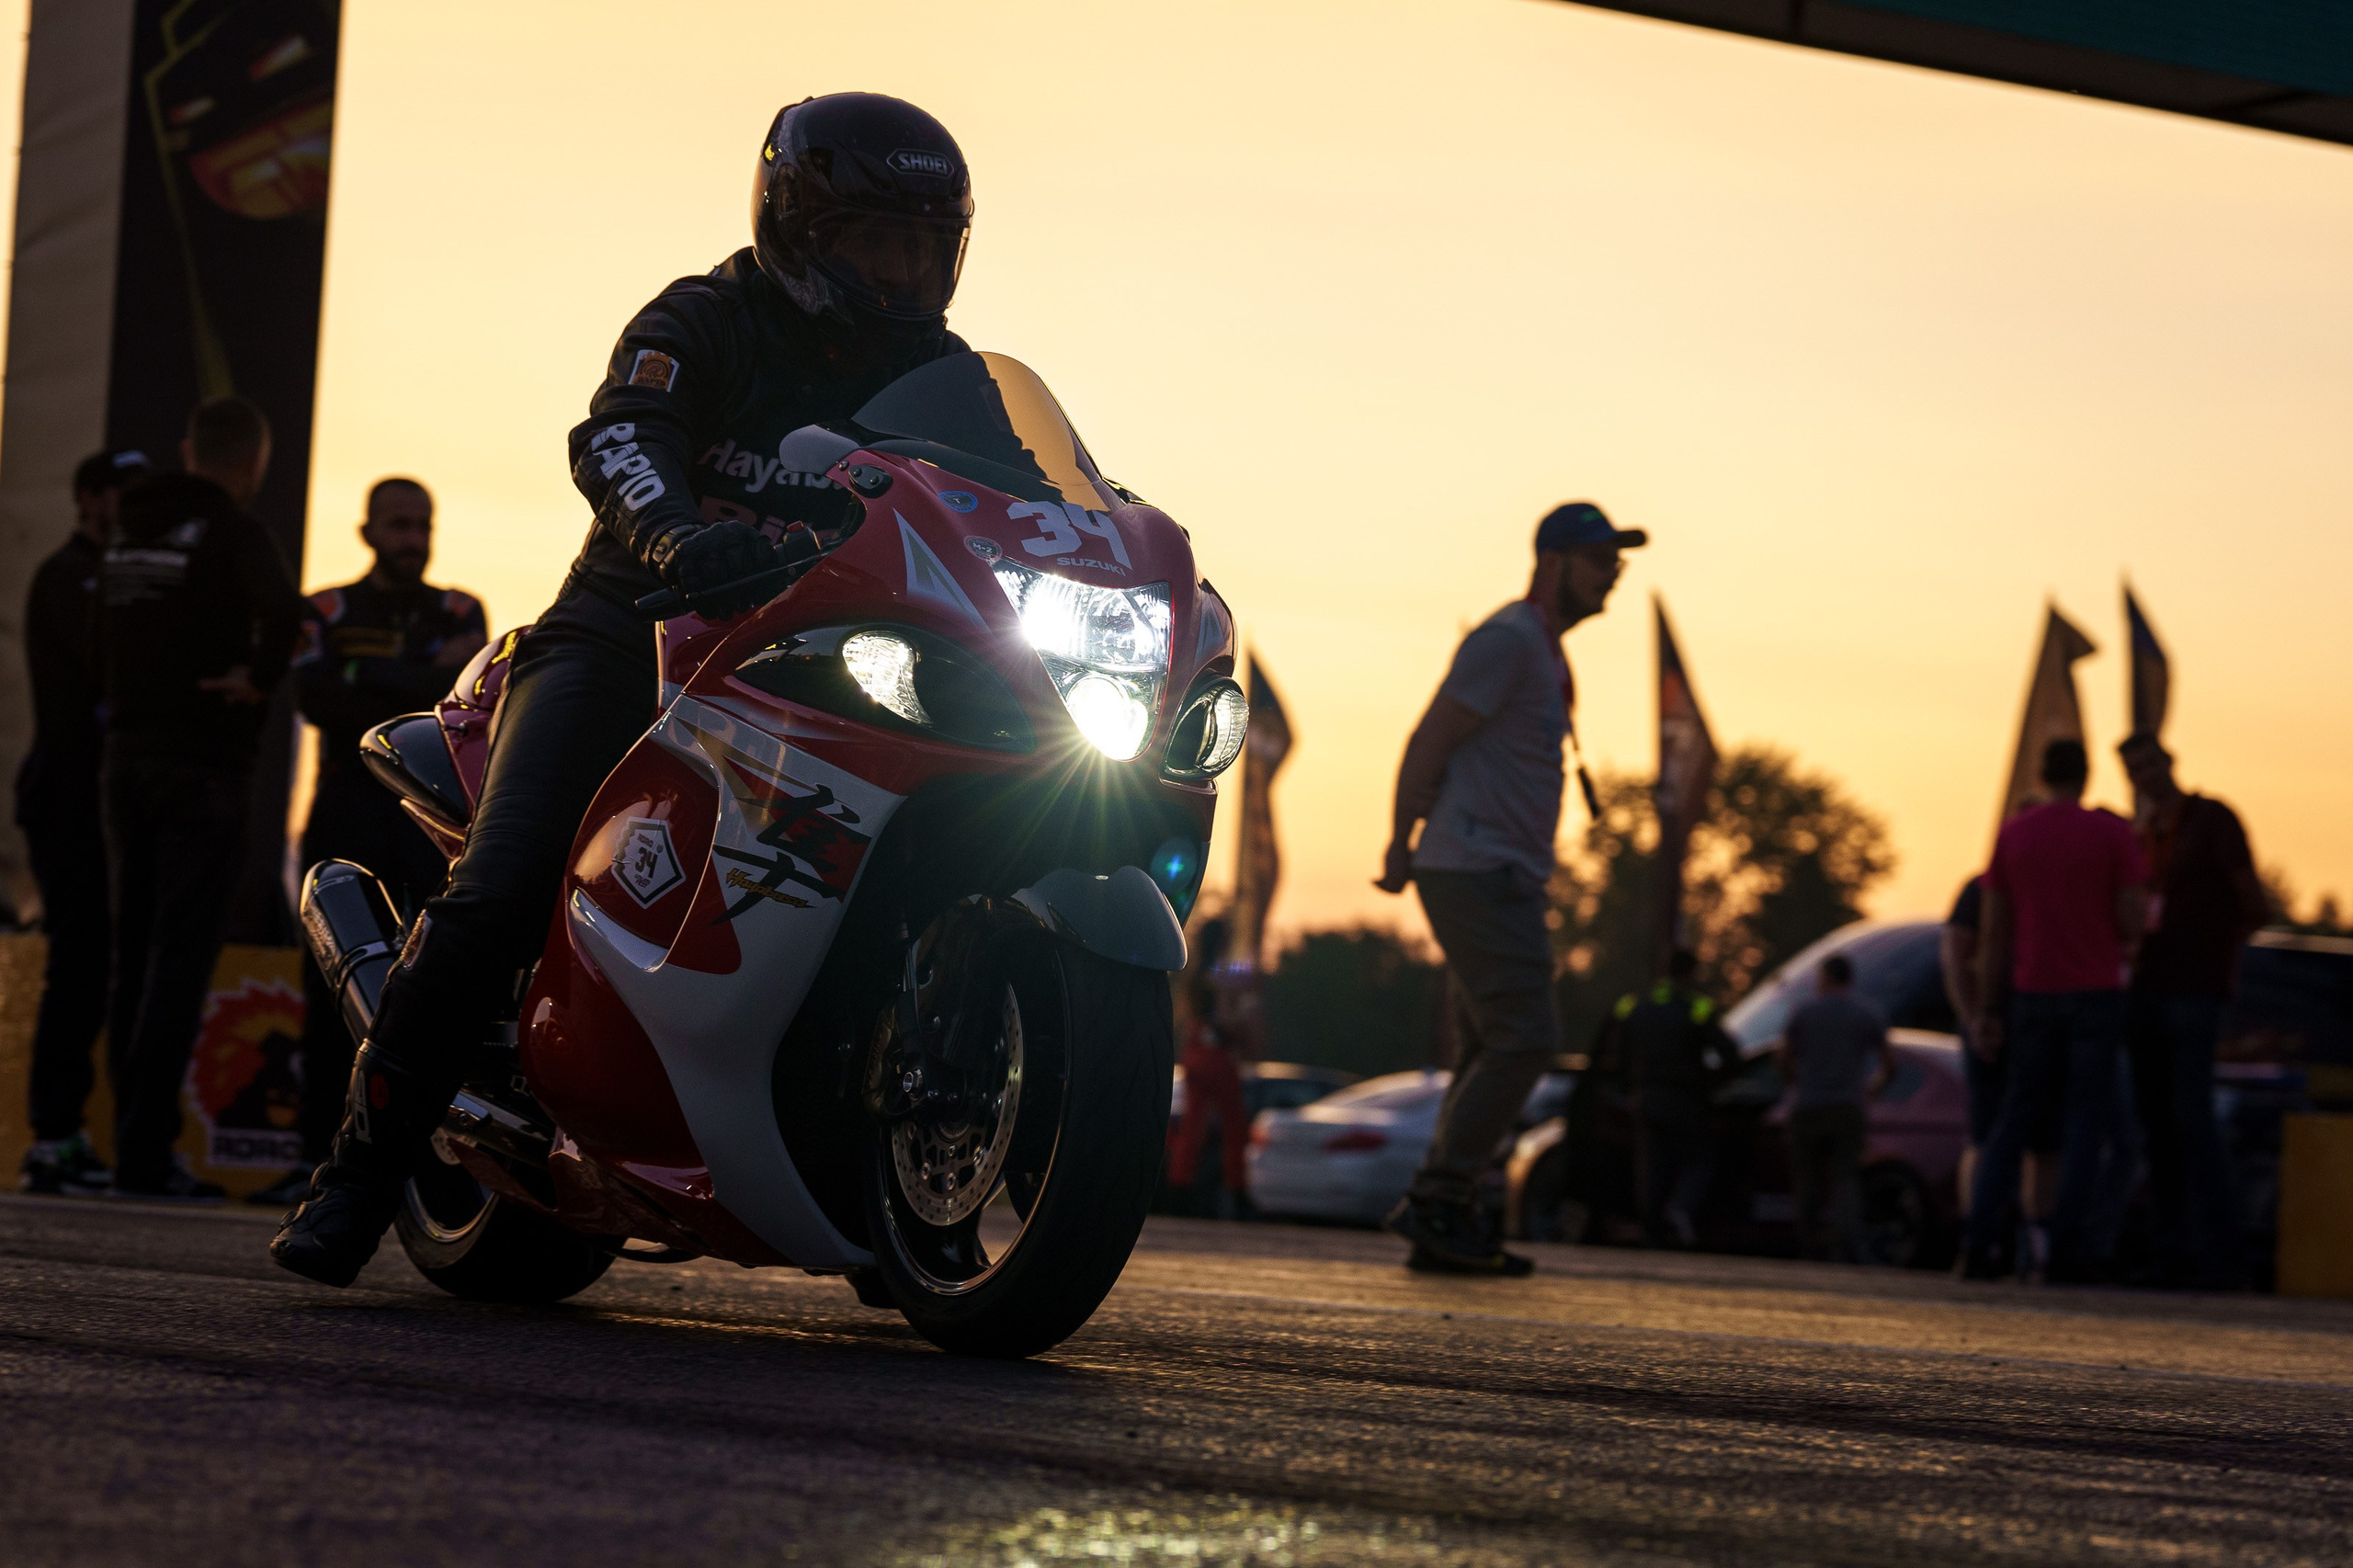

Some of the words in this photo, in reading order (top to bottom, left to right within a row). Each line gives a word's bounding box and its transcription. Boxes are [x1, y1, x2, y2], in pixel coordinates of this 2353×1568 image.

[897, 152, 949, 176] SHOEI
[1006, 500, 1132, 571] 34
[1056, 557, 1126, 577] SUZUKI
[634, 846, 658, 879] 34
[725, 868, 816, 909] Hayabusa
